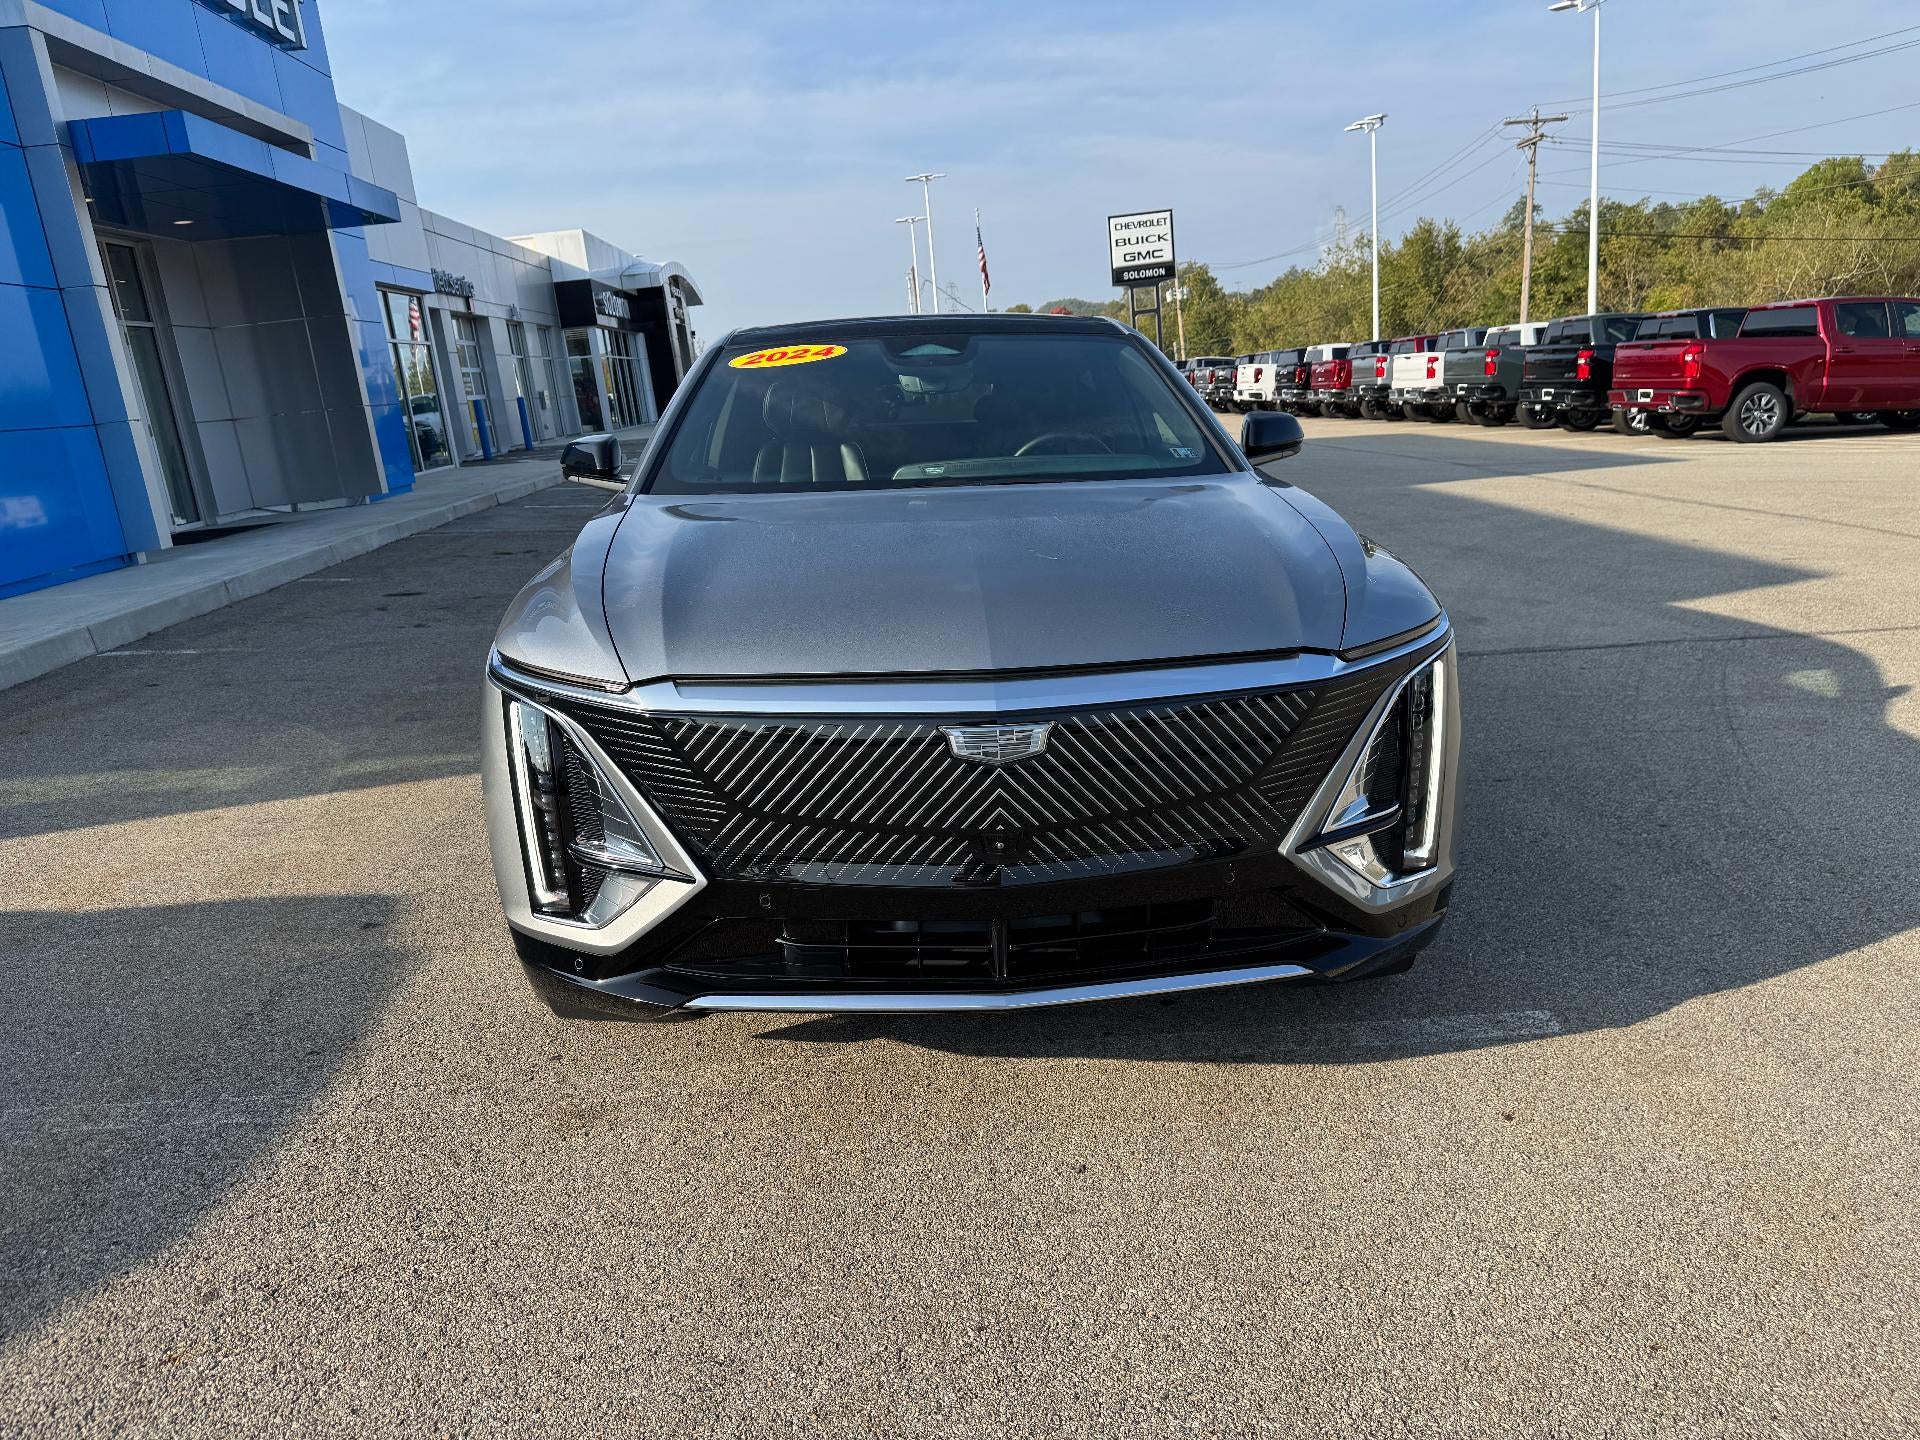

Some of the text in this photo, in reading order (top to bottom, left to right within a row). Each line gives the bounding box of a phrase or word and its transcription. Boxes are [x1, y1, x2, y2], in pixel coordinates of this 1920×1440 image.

[1114, 217, 1168, 230] CHEVROLET
[1115, 233, 1169, 247] BUICK
[1123, 249, 1164, 263] GMC
[1123, 267, 1165, 280] SOLOMON
[740, 346, 835, 365] 2024
